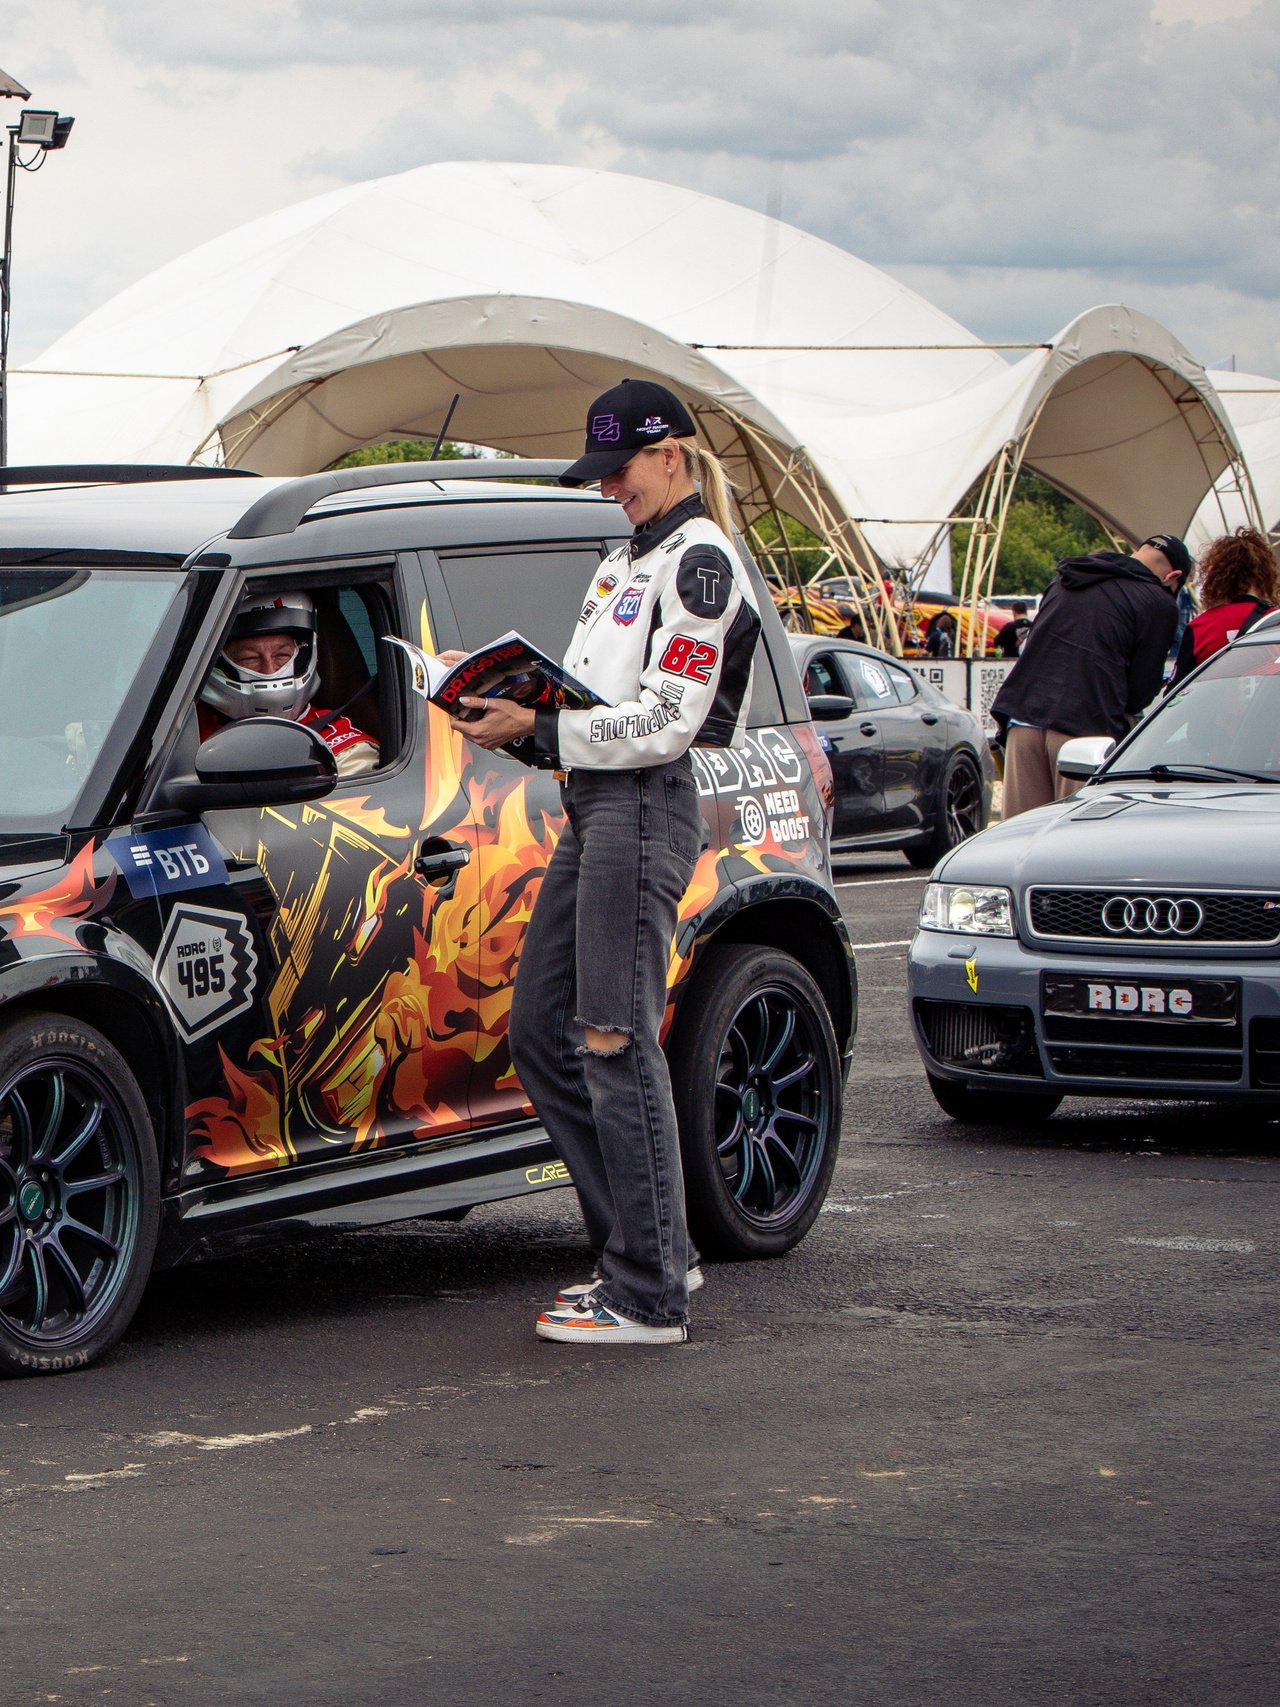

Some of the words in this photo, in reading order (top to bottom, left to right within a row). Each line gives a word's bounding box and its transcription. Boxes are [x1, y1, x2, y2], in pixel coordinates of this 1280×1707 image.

[697, 567, 720, 604] T
[441, 644, 525, 704] DRAGSTRIP
[659, 633, 718, 686] 82
[763, 790, 800, 816] NEED
[770, 816, 810, 843] BOOST
[154, 843, 210, 880] ВТБ
[176, 940, 206, 959] RDRC
[177, 954, 226, 999] 495
[1087, 984, 1193, 1015] RDRC
